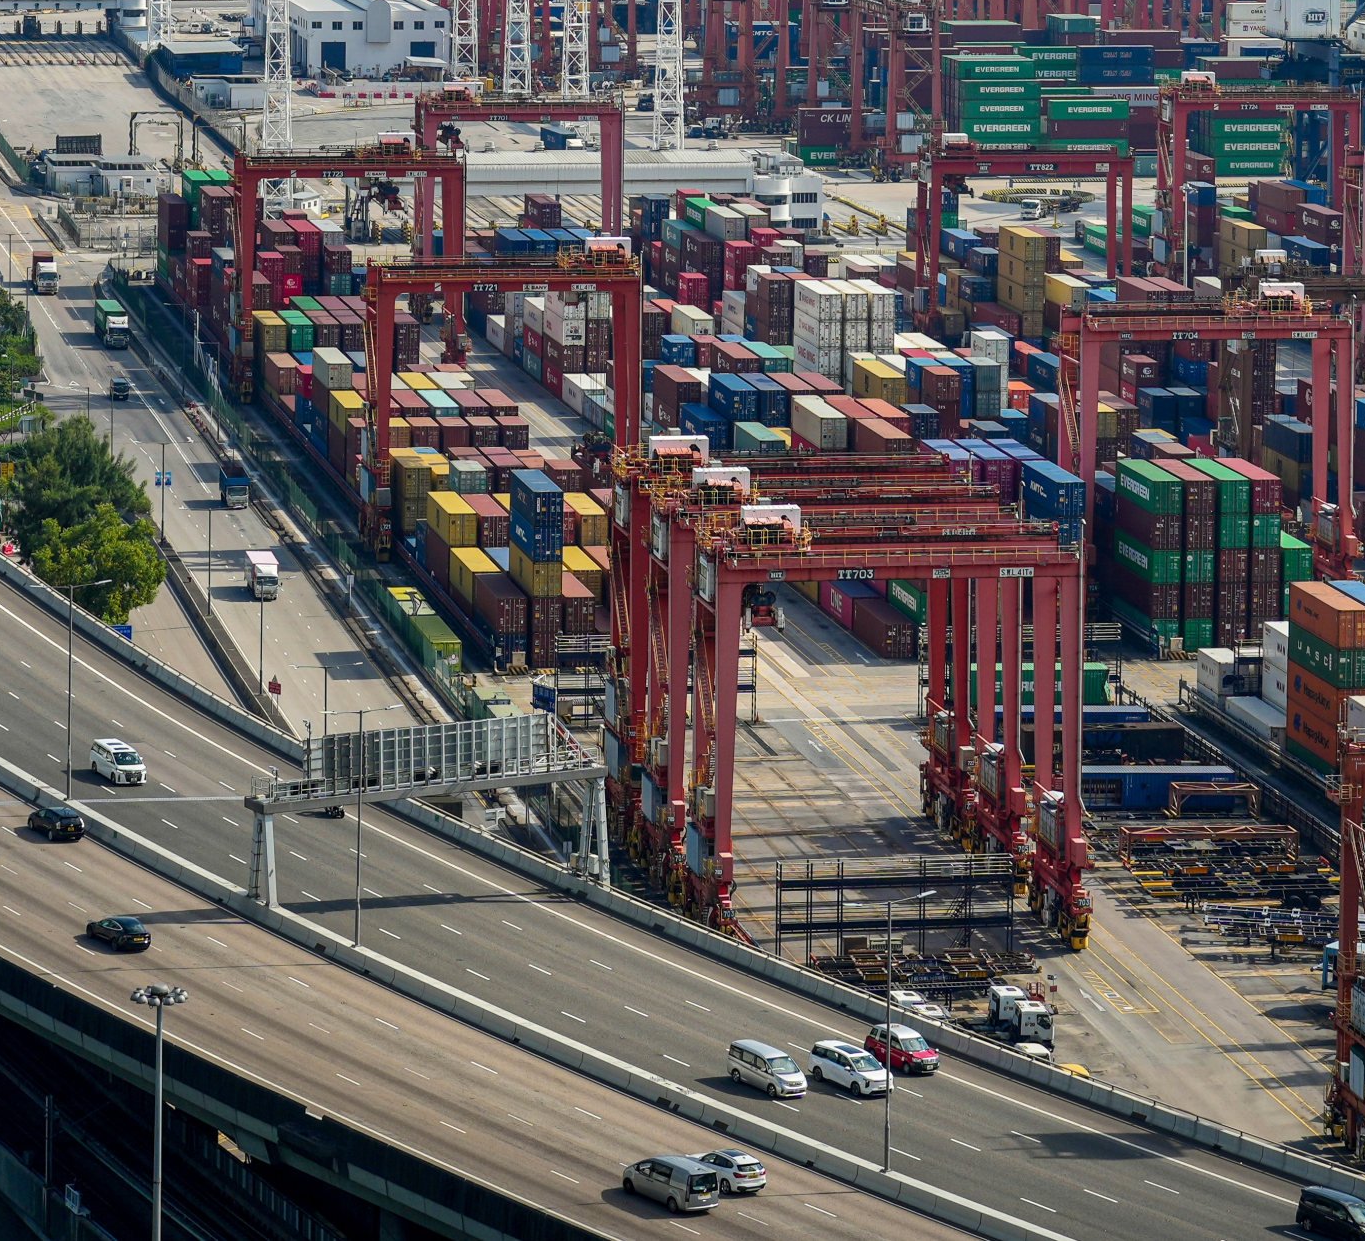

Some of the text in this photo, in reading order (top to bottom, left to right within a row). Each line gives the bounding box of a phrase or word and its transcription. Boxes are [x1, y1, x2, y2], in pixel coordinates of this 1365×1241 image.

[1224, 124, 1280, 132] EVERGREEN
[1121, 474, 1150, 501] EVERGREEN
[1118, 542, 1148, 569] EVERGREEN
[771, 571, 783, 580] HIT
[838, 570, 874, 579] TT703
[892, 583, 917, 609] EVERGREEN
[830, 590, 843, 617] ONE
[1078, 898, 1091, 907] 703
[724, 909, 734, 918] 703
